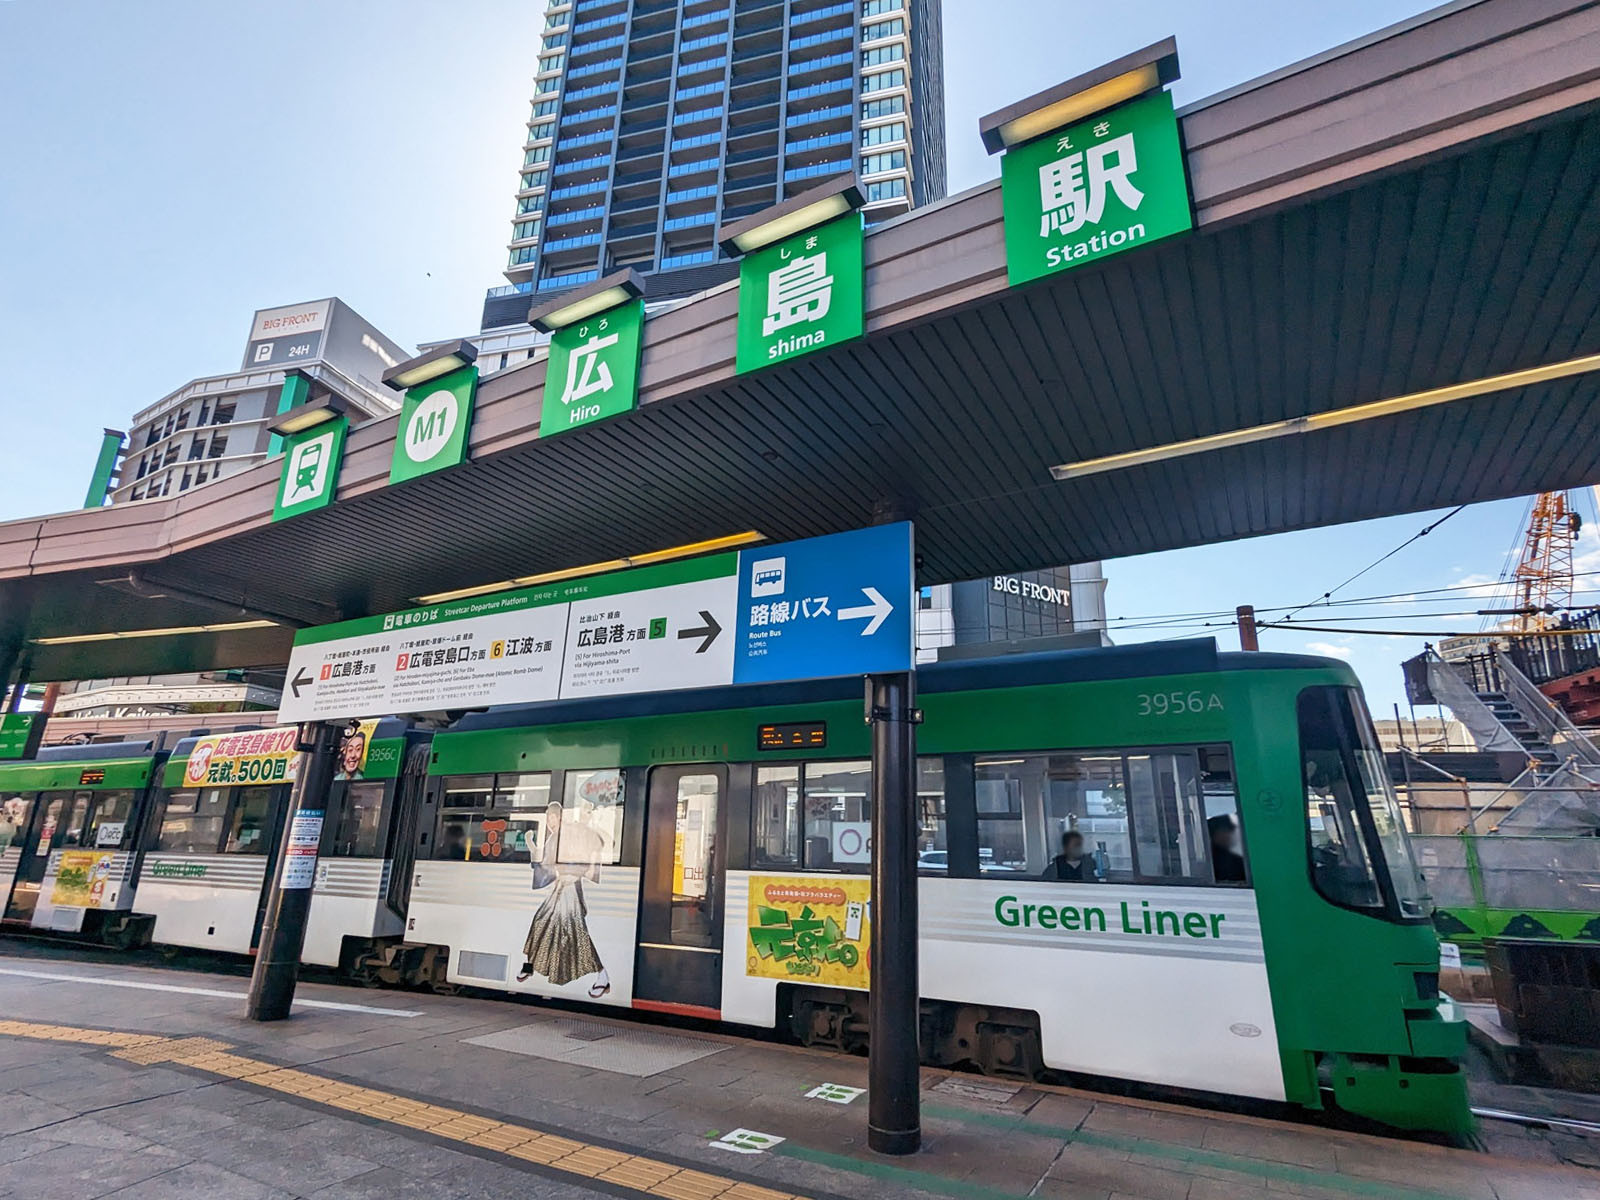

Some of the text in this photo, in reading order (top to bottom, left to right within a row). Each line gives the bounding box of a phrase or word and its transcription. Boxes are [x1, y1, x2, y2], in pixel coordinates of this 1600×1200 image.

[1057, 121, 1110, 153] えき
[1039, 132, 1145, 238] 駅
[781, 236, 818, 259] しま
[1046, 223, 1146, 267] Station
[762, 251, 834, 337] 島
[263, 319, 280, 330] BIG
[282, 312, 318, 327] FRONT
[579, 319, 608, 337] ひろ
[288, 344, 310, 357] 24H
[768, 330, 825, 359] shima
[560, 332, 619, 405] 広
[413, 407, 448, 445] M1
[570, 404, 600, 424] Hiro
[993, 575, 1019, 594] BIG
[1021, 581, 1070, 607] FRONT
[395, 608, 439, 626] 電車のりば
[444, 597, 528, 617] Streetcar Departure Platform
[750, 596, 831, 626] 路線バス
[577, 623, 646, 648] 広島港方面
[749, 629, 781, 639] Route Bus
[409, 646, 486, 669] 広電宮島口方面
[505, 636, 553, 657] 江波方面
[332, 660, 376, 678] 広島港方面
[1137, 691, 1224, 716] 3956A
[213, 730, 297, 757] 広電宮島線10
[369, 747, 397, 762] 3956C
[994, 895, 1226, 939] Green Liner
